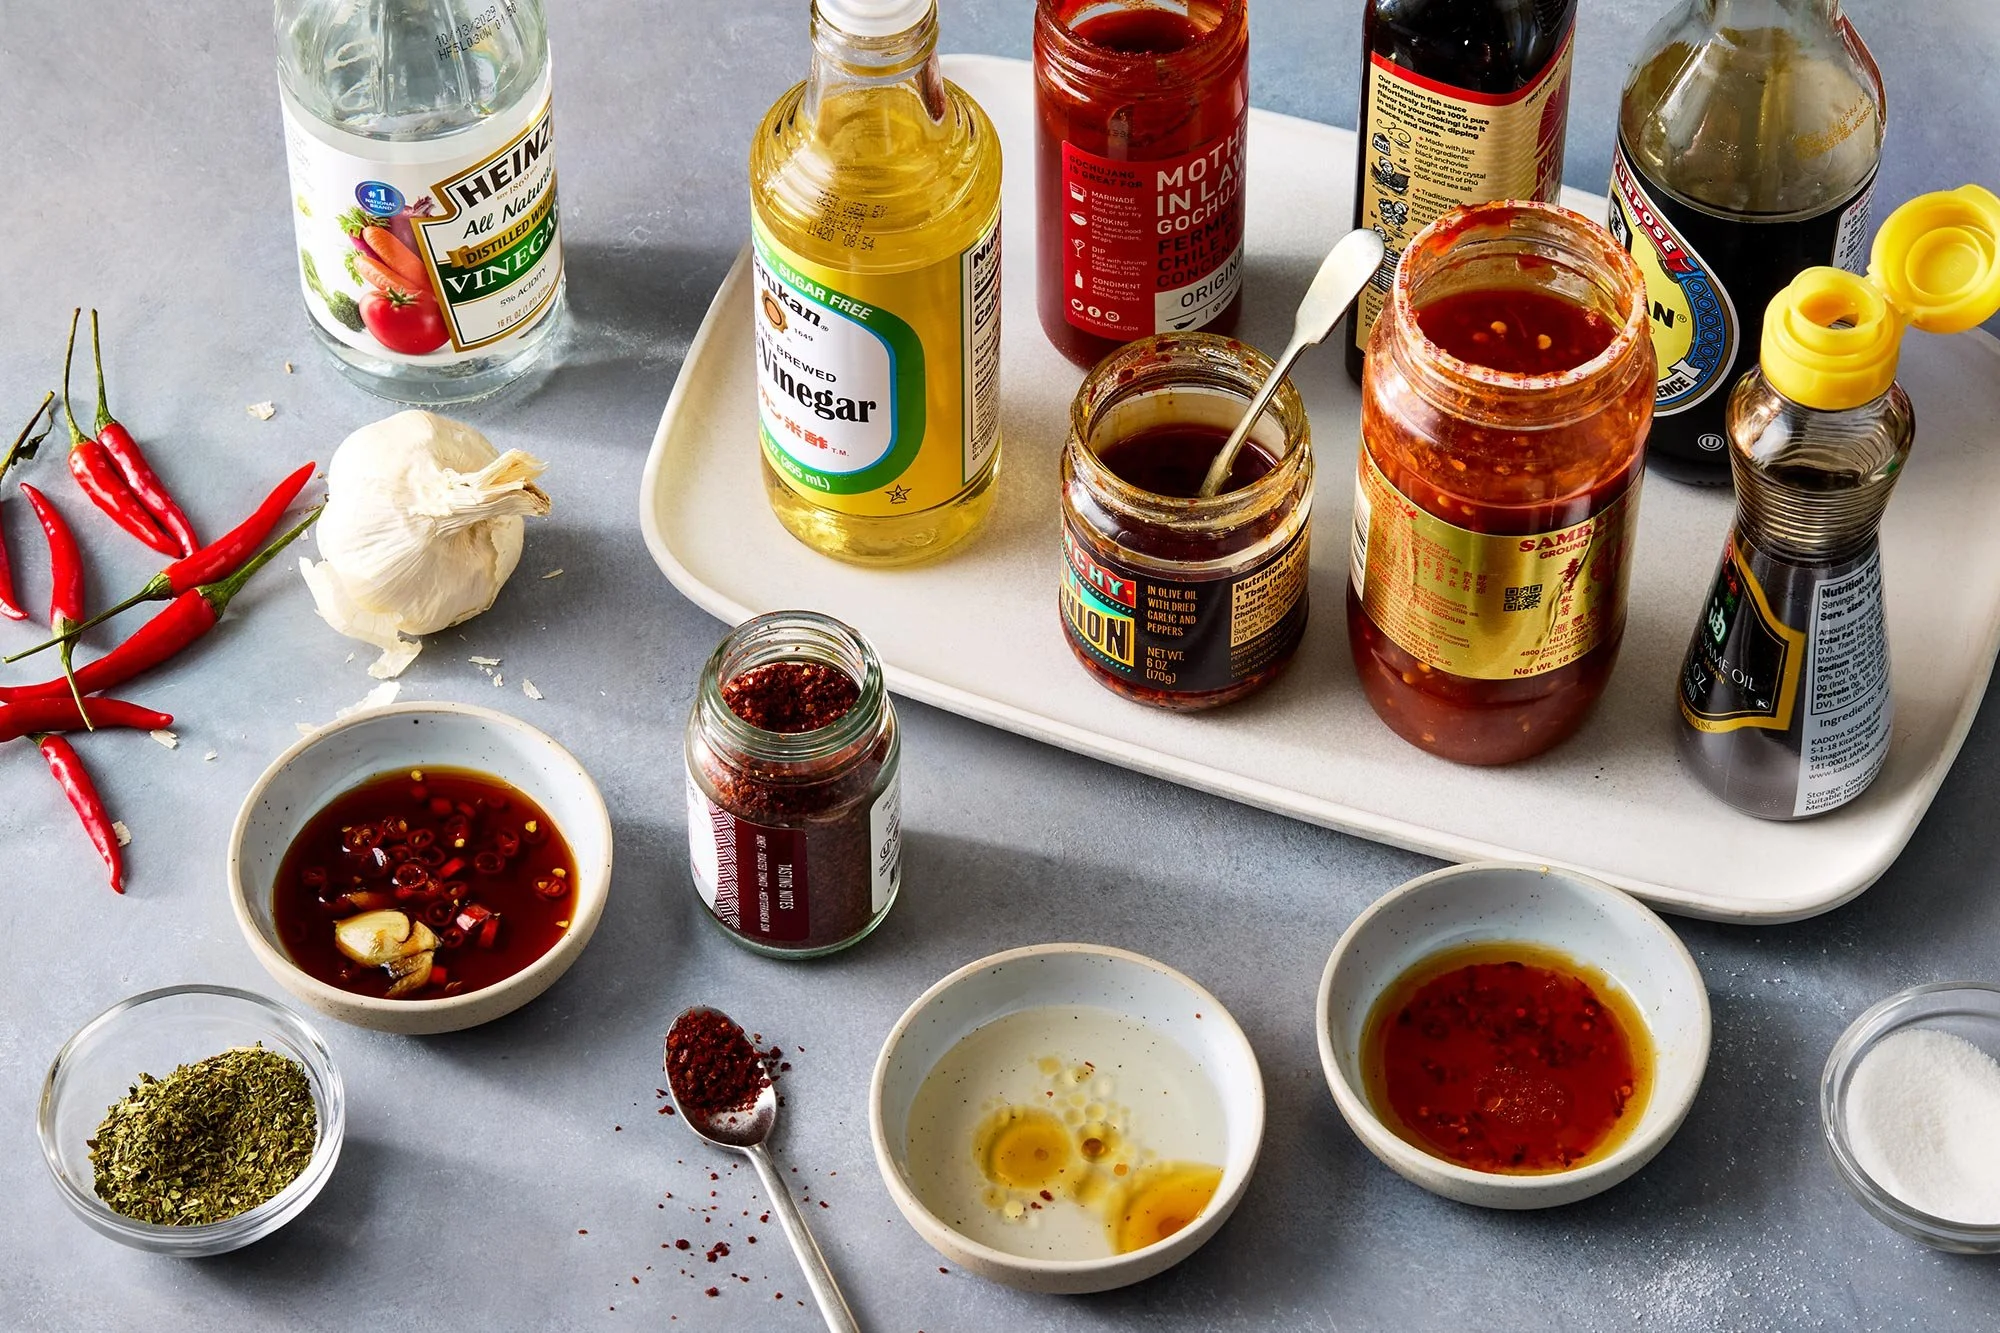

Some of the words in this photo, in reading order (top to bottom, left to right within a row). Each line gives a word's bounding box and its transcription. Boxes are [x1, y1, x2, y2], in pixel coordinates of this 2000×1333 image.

[1378, 74, 1391, 85] Our
[1392, 82, 1426, 101] premium
[1427, 96, 1442, 107] fish
[1443, 102, 1467, 113] sauce
[1377, 82, 1419, 107] effortlessly
[1420, 101, 1446, 116] brings
[1448, 110, 1469, 122] 100%
[1470, 117, 1490, 126] pure
[1377, 89, 1398, 104] flavor
[1398, 100, 1407, 109] to
[1407, 104, 1426, 117] your
[1426, 112, 1461, 128] cooking!
[1462, 122, 1478, 132] Use
[1479, 124, 1486, 133] it
[1376, 105, 1403, 123] sauces,
[1403, 119, 1418, 130] and
[1419, 126, 1441, 138] more.
[1384, 101, 1397, 112] stir
[1398, 108, 1416, 122] fries,
[1417, 117, 1446, 132] curries,
[1447, 126, 1480, 140] dipping
[1415, 141, 1429, 151] two
[1429, 147, 1470, 162] ingredients:
[1425, 137, 1445, 148] Made
[1445, 143, 1461, 152] with
[1461, 147, 1476, 157] just
[456, 114, 550, 208] HEINZ
[1070, 155, 1135, 179] GOCHUJANG
[1414, 149, 1433, 160] black
[1433, 155, 1469, 169] anchovies
[1414, 156, 1438, 170] caught
[1449, 166, 1462, 175] the
[1462, 170, 1487, 180] crystal
[1070, 163, 1079, 175] IS
[1082, 171, 1117, 186] GREAT
[1413, 164, 1430, 174] clear
[1431, 169, 1455, 181] waters
[368, 189, 386, 201] #1
[1432, 178, 1446, 187] and
[1459, 185, 1473, 193] salt
[365, 198, 397, 207] NATIONAL
[1092, 191, 1136, 204] MARINADE
[1157, 168, 1245, 235] GOCHUJA
[1157, 189, 1191, 217] IN
[1412, 193, 1448, 209] fermented
[1421, 188, 1463, 205] Traditionally
[370, 203, 393, 211] BRAND
[1412, 201, 1439, 214] months
[463, 213, 495, 239] All
[1092, 214, 1129, 227] COOKING
[466, 220, 530, 264] DISTILLED
[1092, 246, 1106, 254] DIP
[1158, 236, 1220, 272] CHILE
[517, 264, 547, 298] ACIDITY
[1092, 276, 1141, 290] CONDIMENT
[1181, 247, 1243, 308] ORIGINA
[753, 250, 821, 327] arukan
[779, 262, 827, 301] SUGAR
[829, 294, 873, 320] FREE
[794, 328, 814, 342] 1649
[776, 344, 837, 383] BREWED
[761, 336, 877, 423] Vinegar
[806, 472, 831, 491] mL)
[1519, 523, 1593, 552] SAMB
[1539, 539, 1589, 559] GROUND
[1235, 561, 1283, 593] Nutrition
[1822, 575, 1865, 598] Nutrition
[1147, 585, 1156, 595] IN
[1158, 587, 1182, 599] OLIVE
[1184, 590, 1197, 600] OIL
[1234, 598, 1256, 612] Total
[1257, 590, 1269, 602] Fat
[1244, 585, 1267, 600] Tbsp
[1821, 593, 1857, 610] Servings:
[1147, 597, 1170, 610] WITH
[1172, 602, 1196, 612] DRIED
[1234, 602, 1266, 620] Cholest.
[1820, 610, 1845, 621] Serv.
[1846, 598, 1866, 613] size:
[1147, 609, 1177, 624] GARLIC
[1179, 615, 1197, 625] AND
[1818, 623, 1846, 636] Amount
[1847, 618, 1857, 629] per
[1147, 622, 1184, 637] PEPPERS
[1549, 631, 1569, 644] HUY
[1818, 634, 1840, 646] Total
[1842, 629, 1855, 640] Fat
[1147, 646, 1166, 659] NET
[1167, 650, 1185, 661] WT.
[1817, 646, 1835, 655] DV).
[1837, 637, 1856, 650] Trans
[1146, 658, 1153, 668] 6
[1155, 659, 1167, 671] OZ
[1513, 666, 1534, 675] Net
[1536, 662, 1554, 672] Wt.
[1557, 655, 1569, 664] 18
[1703, 656, 1725, 685] JAPAN
[1817, 660, 1850, 673] Sodium
[1146, 668, 1176, 685] (170g)
[1731, 668, 1756, 692] OIL
[1817, 674, 1833, 684] (0%
[1816, 684, 1828, 693] 0g
[1816, 685, 1850, 700] Protein
[1836, 693, 1852, 705] Iron
[1820, 693, 1877, 728] Ingredients:
[1811, 731, 1846, 746] KADOYA
[1846, 713, 1874, 736] SESAME
[1864, 724, 1880, 740] Tokyo
[1810, 743, 1837, 754] 5-1-18
[1810, 755, 1847, 771] 141-0001
[1848, 742, 1870, 759] JAPAN
[1807, 785, 1844, 799] Storage:
[1845, 772, 1863, 787] Cool
[1805, 797, 1842, 811] Medium
[1806, 790, 1842, 805] Suitable
[778, 864, 793, 889] TASTING
[779, 890, 794, 910] NOTES
